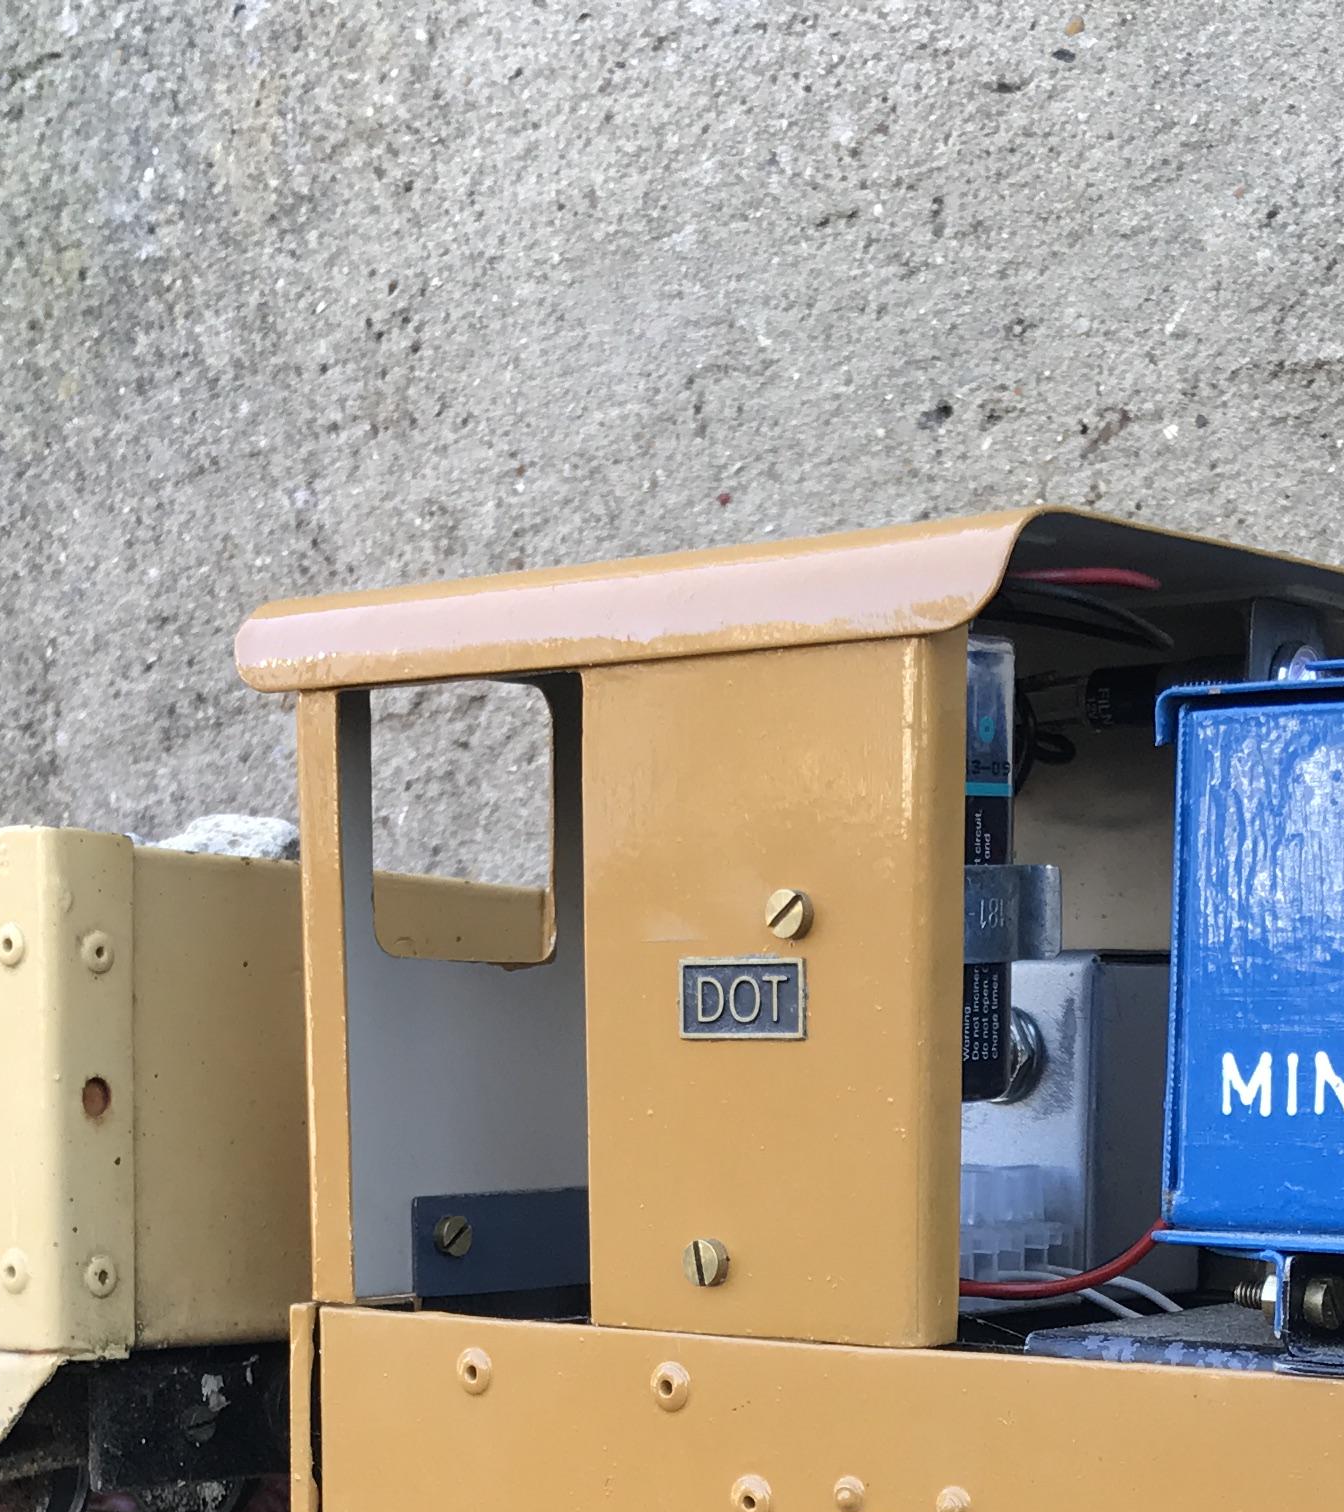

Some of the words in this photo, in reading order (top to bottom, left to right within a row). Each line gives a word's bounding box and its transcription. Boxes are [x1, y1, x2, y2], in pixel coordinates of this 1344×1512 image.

[984, 833, 992, 859] and
[697, 975, 789, 1023] DOT
[962, 1006, 972, 1061] Warning
[972, 1041, 980, 1060] Do
[982, 1042, 989, 1060] do
[992, 1014, 1000, 1059] charge
